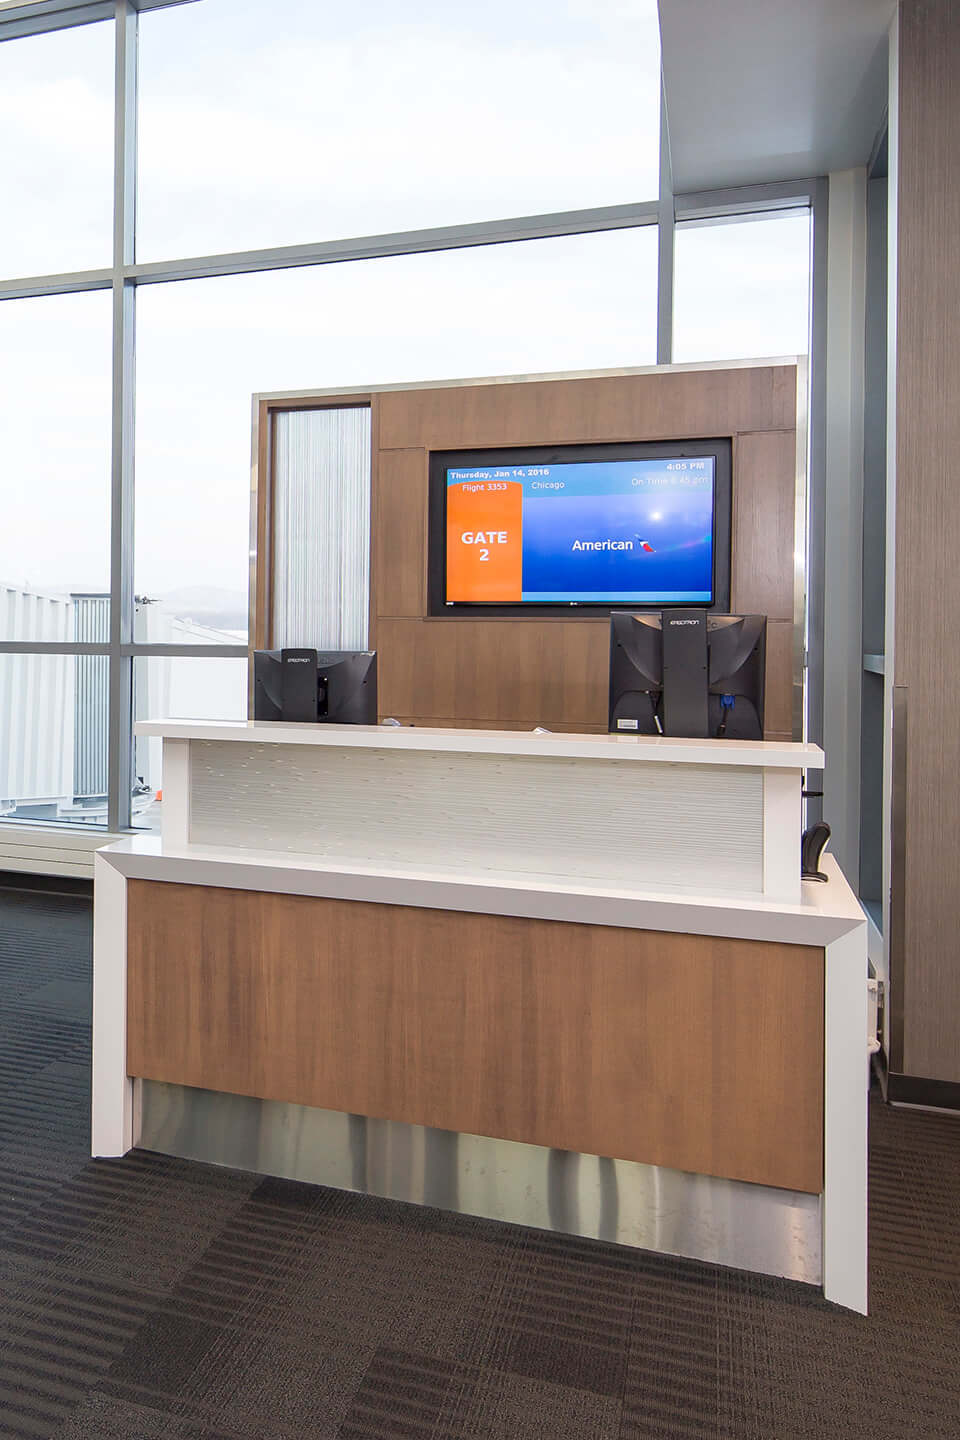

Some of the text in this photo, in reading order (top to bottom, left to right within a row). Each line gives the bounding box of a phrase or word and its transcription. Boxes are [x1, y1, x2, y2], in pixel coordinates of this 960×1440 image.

[666, 462, 705, 471] 4:05 PM
[450, 471, 492, 479] Thursday,
[494, 470, 510, 478] Jan
[512, 469, 526, 478] 14,
[462, 483, 485, 492] Flight
[531, 481, 565, 491] Chicago
[461, 531, 508, 545] GATE
[572, 539, 633, 551] American
[479, 549, 489, 561] 2
